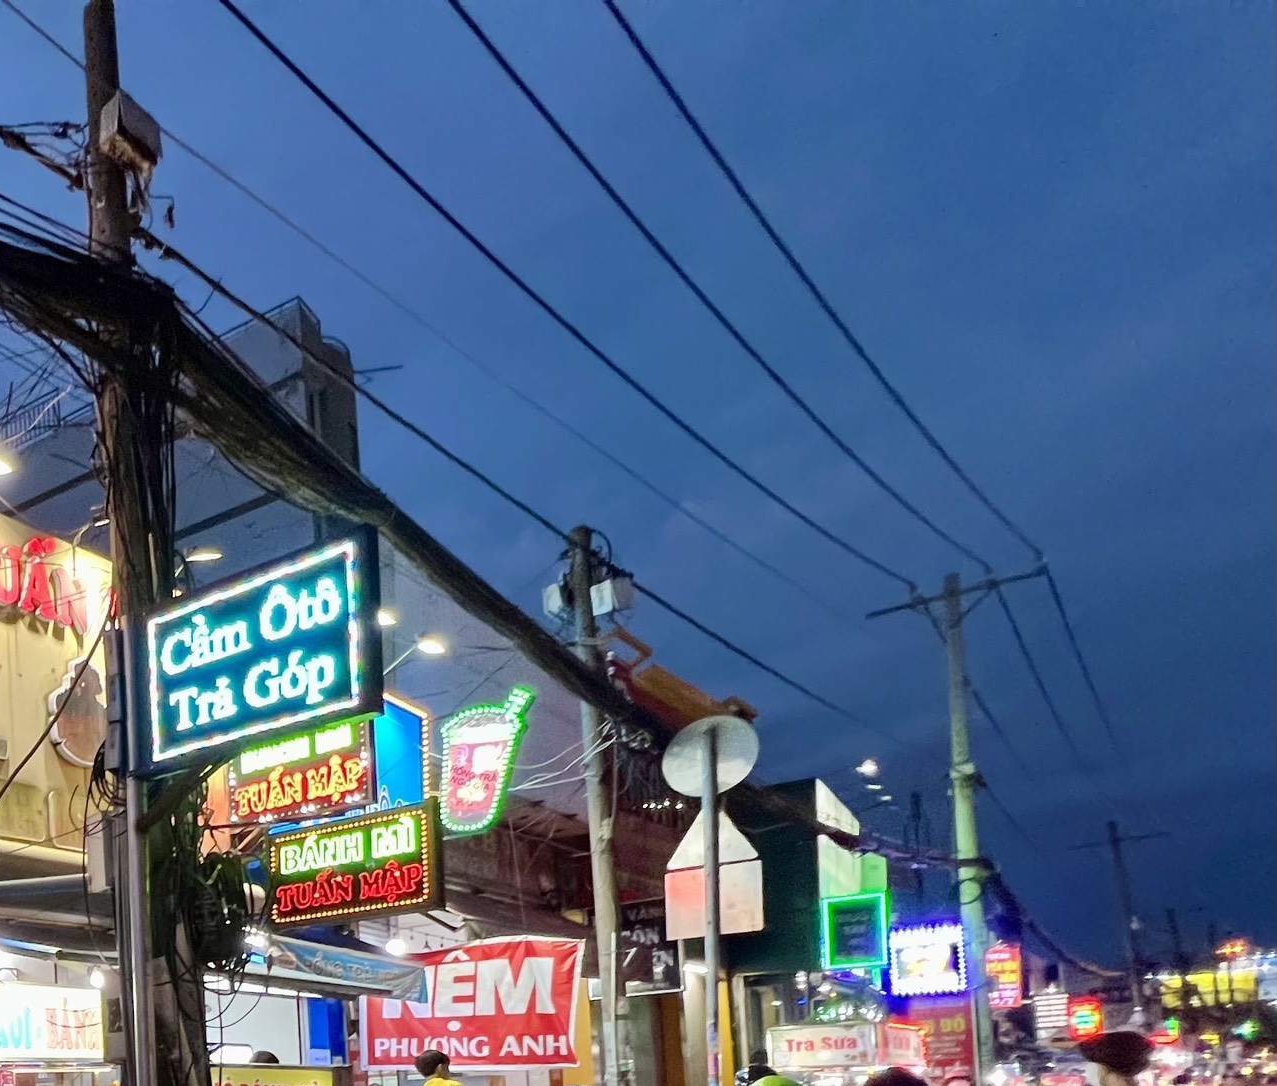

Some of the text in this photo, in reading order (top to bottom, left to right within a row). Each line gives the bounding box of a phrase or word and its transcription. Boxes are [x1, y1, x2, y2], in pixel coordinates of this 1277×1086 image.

[160, 614, 252, 677] Cầm
[169, 649, 336, 732] Trả Góp
[306, 754, 364, 803] MẬP
[279, 832, 364, 876] BÁNH
[275, 859, 424, 912] TUẤN MẬP
[498, 1034, 569, 1057] ANH
